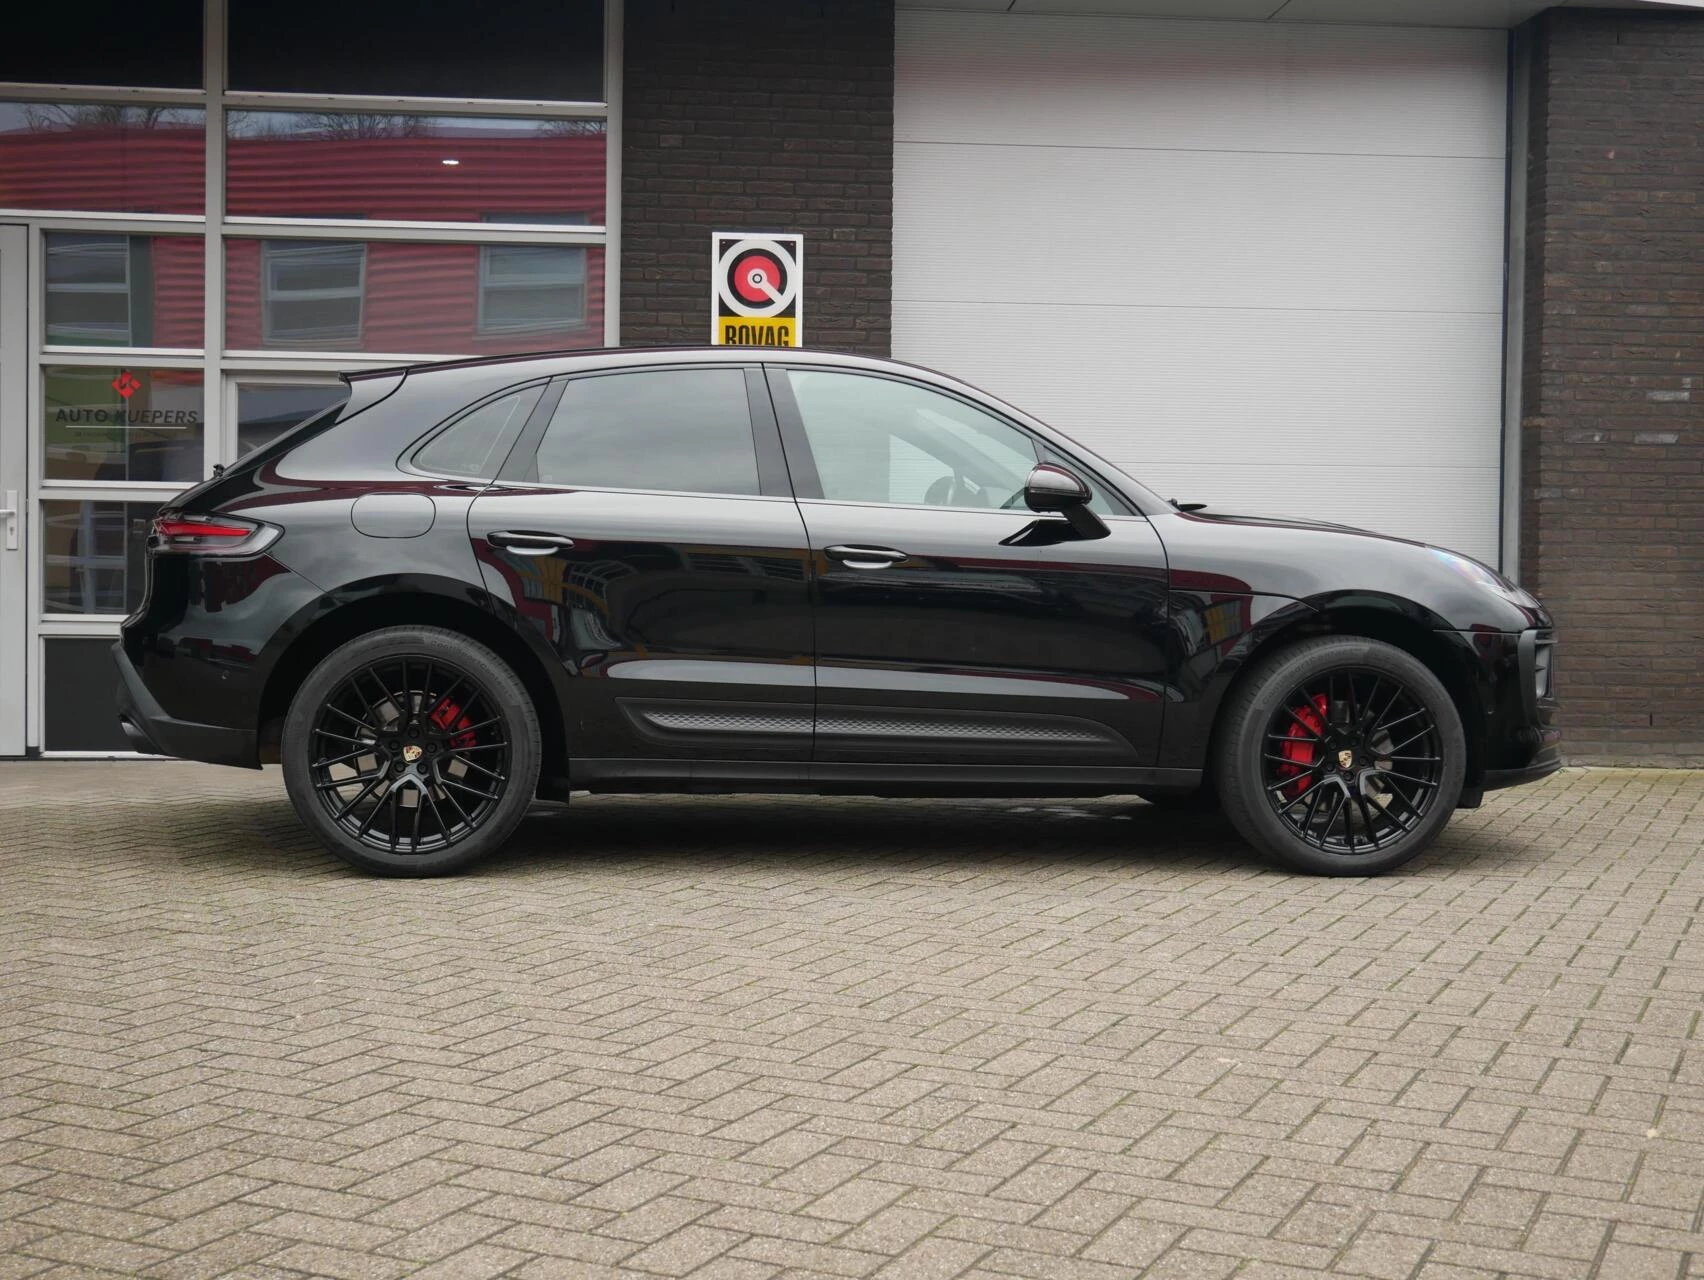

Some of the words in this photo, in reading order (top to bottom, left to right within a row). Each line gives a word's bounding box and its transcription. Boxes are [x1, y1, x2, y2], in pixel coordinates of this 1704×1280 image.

[725, 325, 789, 346] BOVAG
[56, 409, 108, 422] AUTO
[115, 409, 199, 424] KUEPERS
